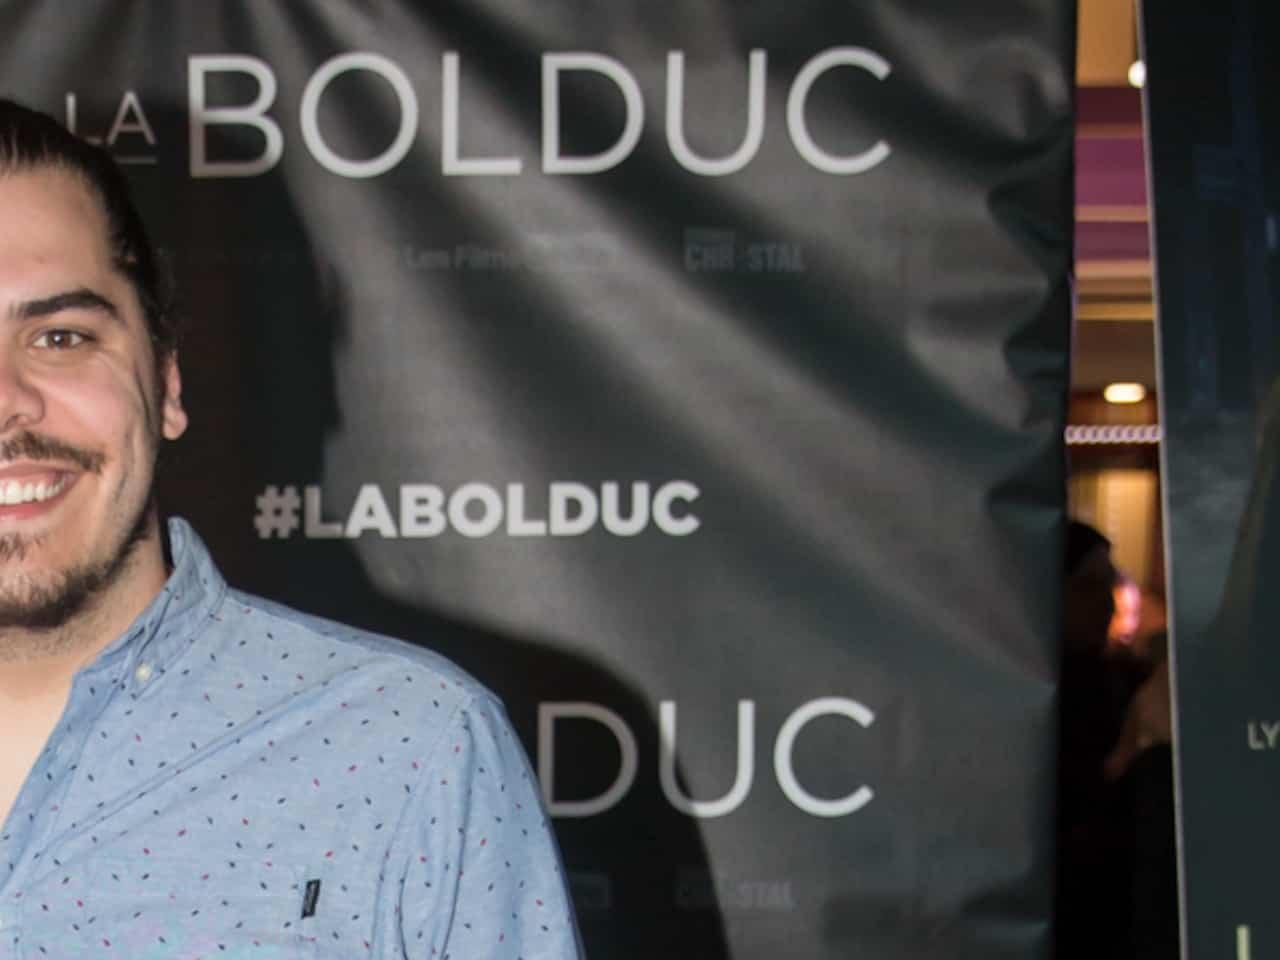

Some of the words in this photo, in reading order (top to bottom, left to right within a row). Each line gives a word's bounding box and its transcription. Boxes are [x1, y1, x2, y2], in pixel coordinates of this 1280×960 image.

[64, 90, 155, 146] LA
[188, 47, 891, 178] BOLDUC
[254, 479, 701, 539] #LABOLDUC
[537, 697, 874, 818] DUC
